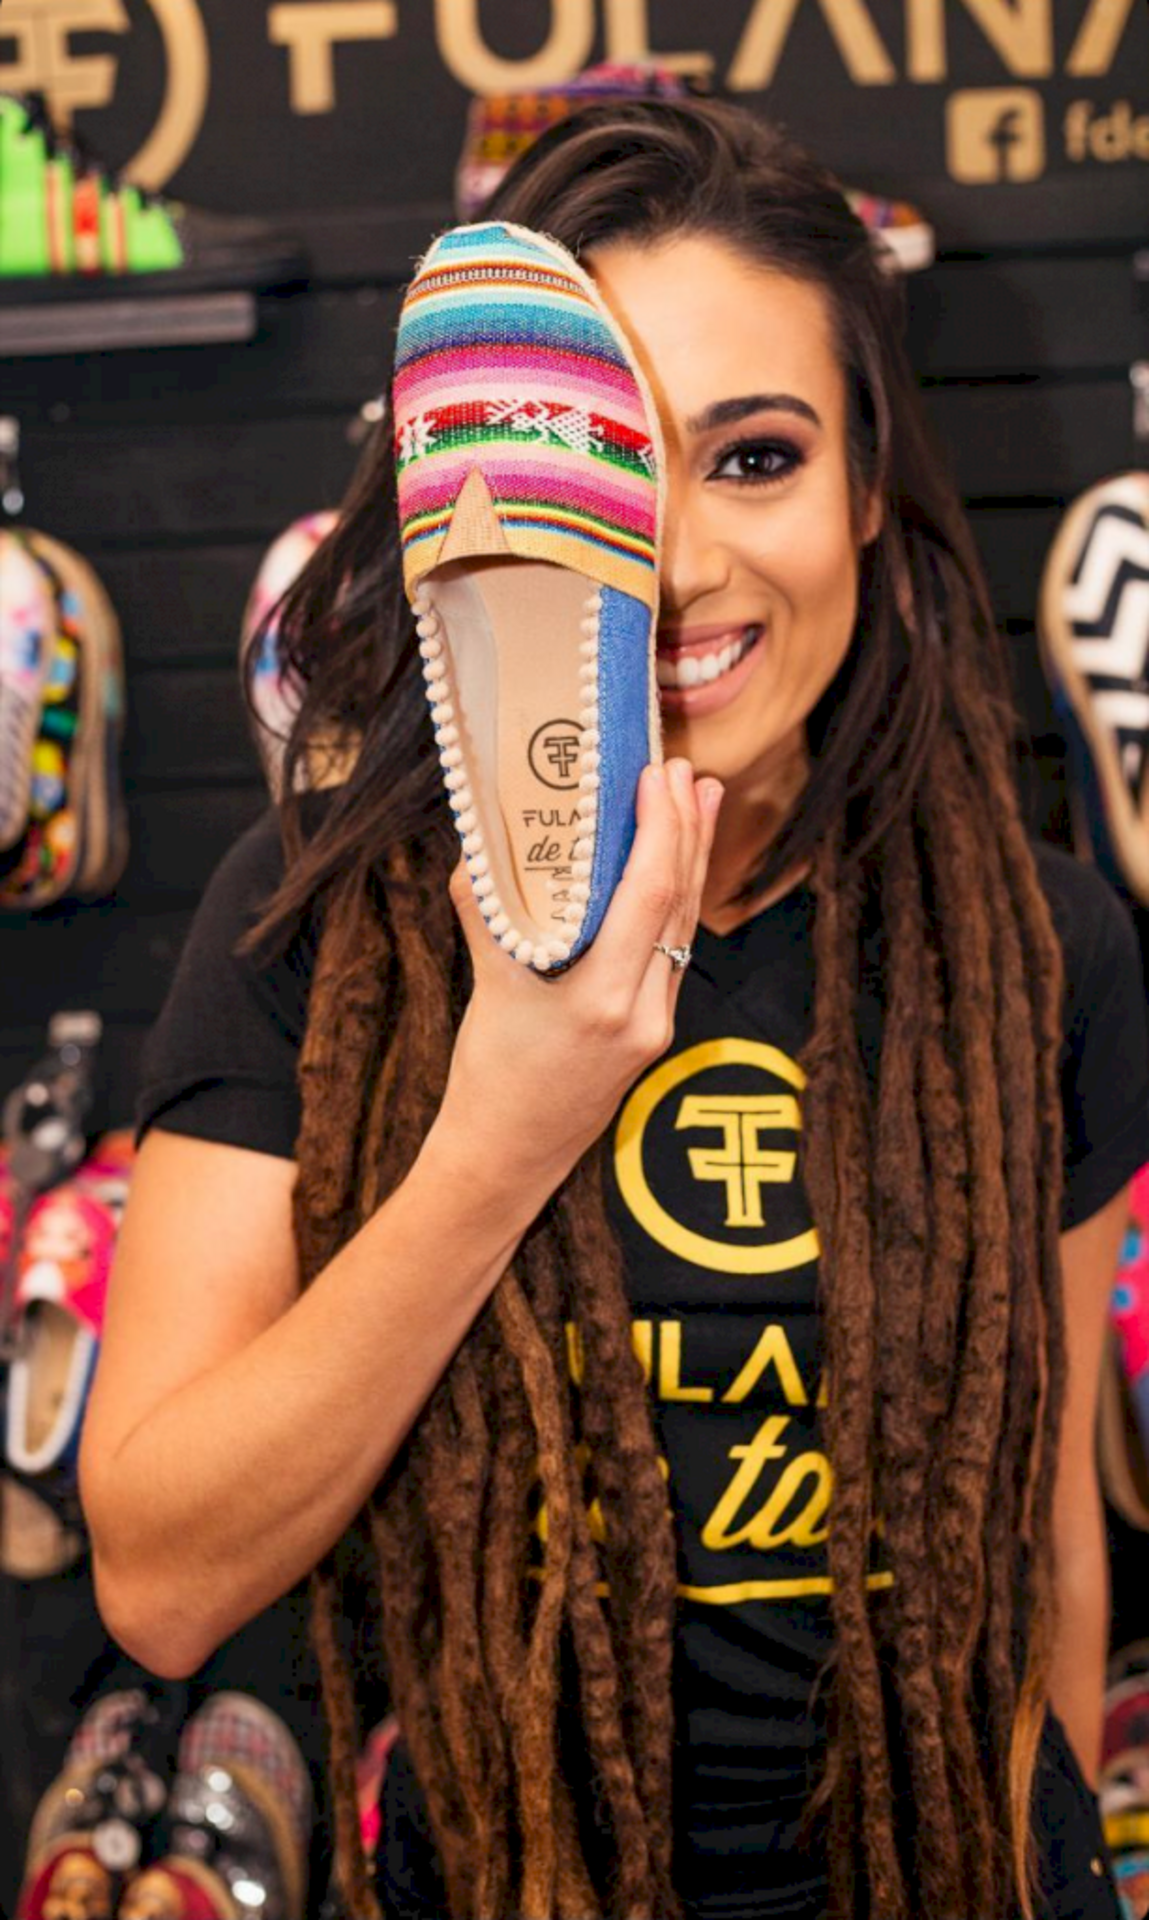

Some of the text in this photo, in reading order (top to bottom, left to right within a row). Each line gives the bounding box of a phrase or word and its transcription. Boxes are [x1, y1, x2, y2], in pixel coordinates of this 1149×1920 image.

[522, 808, 582, 828] FULA
[526, 834, 562, 863] de
[701, 1415, 833, 1549] ta
